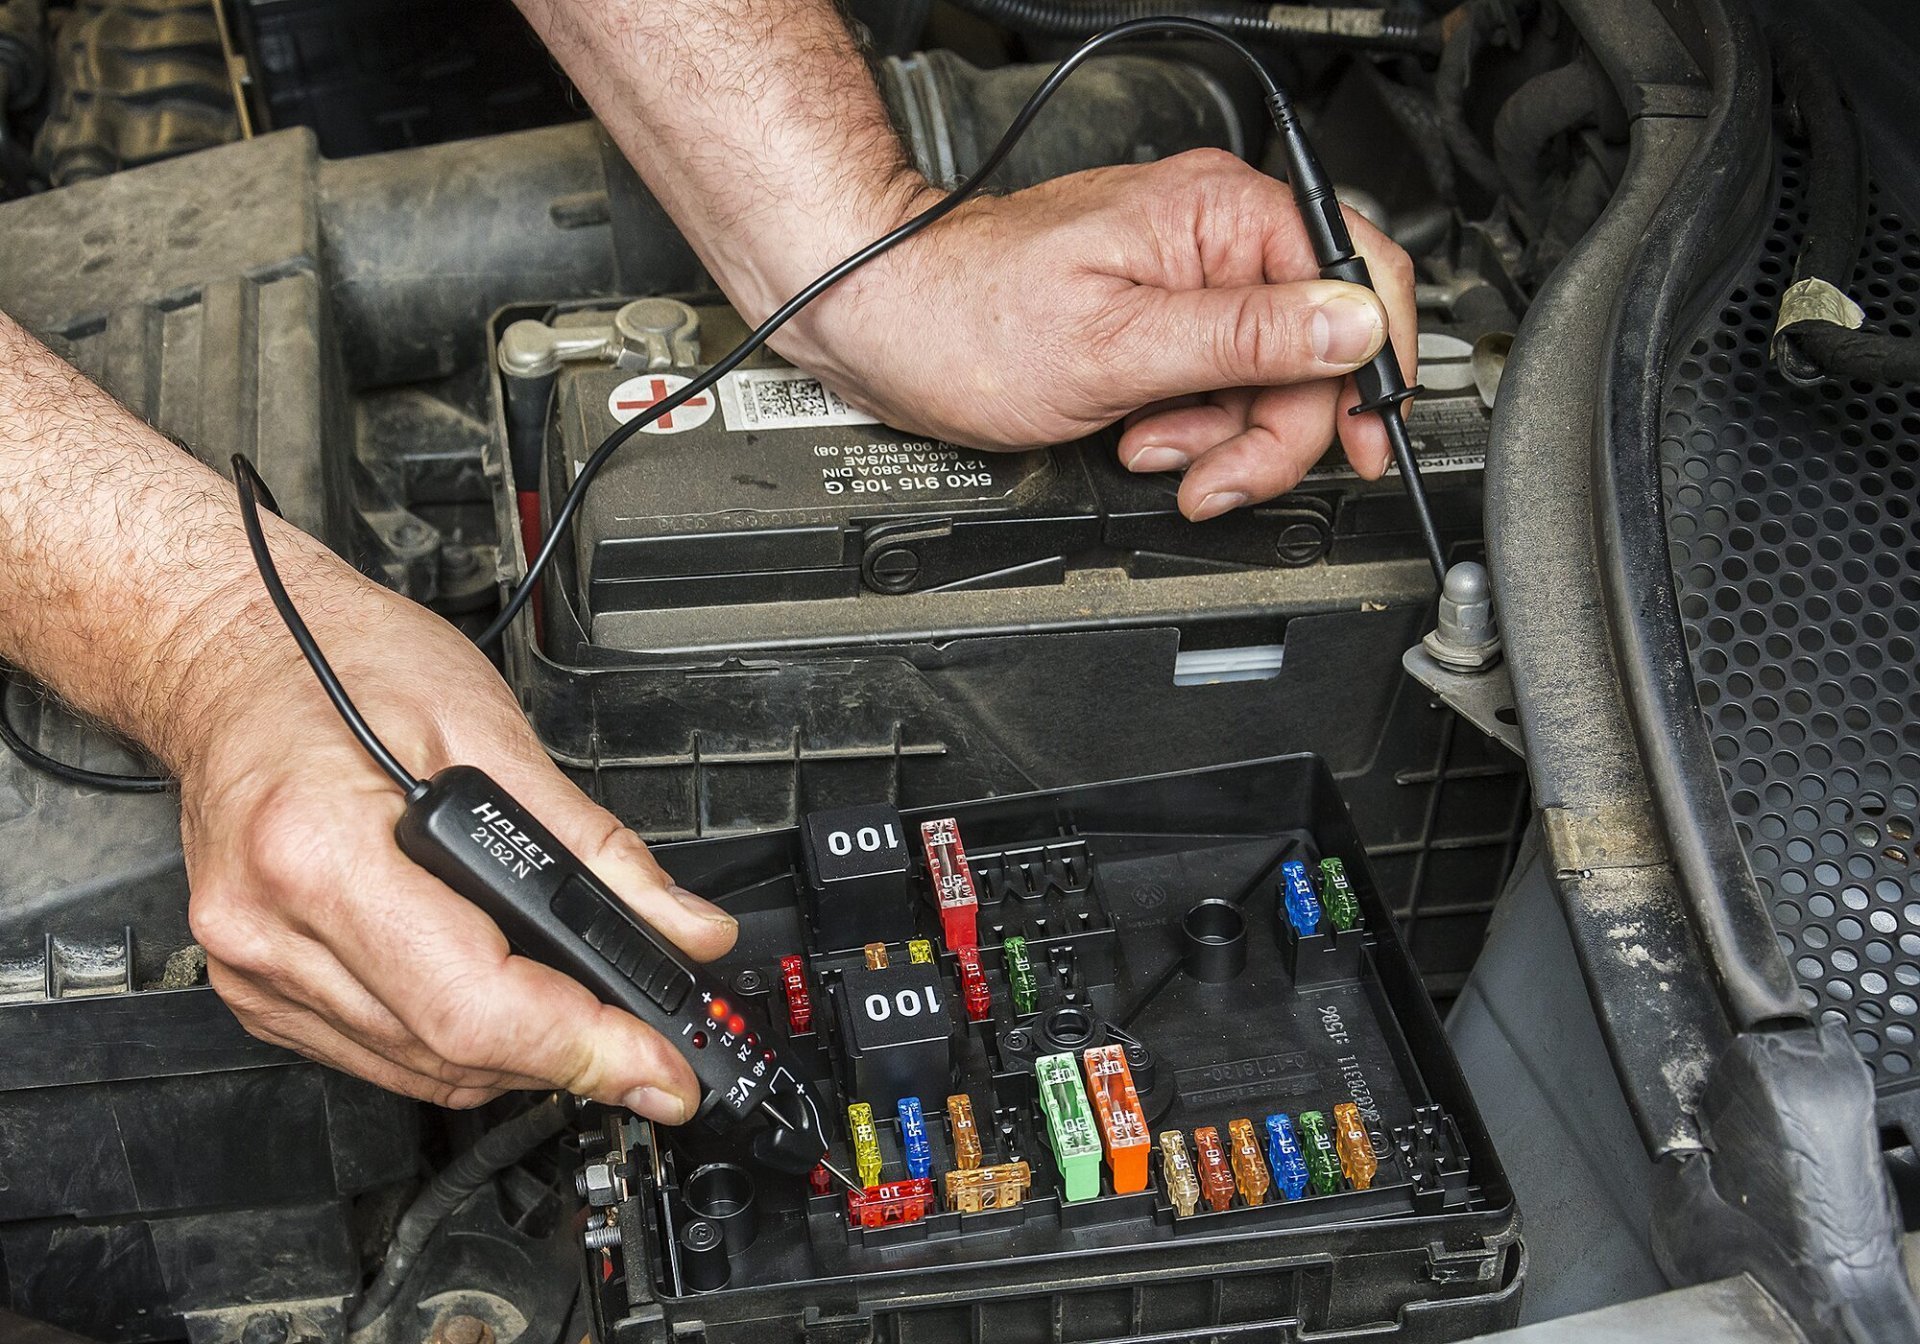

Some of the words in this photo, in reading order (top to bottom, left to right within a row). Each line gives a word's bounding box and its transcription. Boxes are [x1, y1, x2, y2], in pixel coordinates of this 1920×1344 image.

[813, 445, 839, 457] 08)
[844, 445, 863, 454] 04
[868, 443, 898, 453] 982
[902, 442, 932, 452] 906
[844, 453, 910, 466] EN/SAE
[929, 451, 959, 461] 640
[822, 467, 854, 478] DIN
[907, 462, 950, 473] 72Ah
[954, 460, 987, 471] 12V
[824, 481, 845, 495] G
[851, 479, 893, 493] 105
[898, 476, 940, 491] 915
[946, 473, 993, 488] 5K0
[471, 802, 556, 866] HAZET
[828, 823, 899, 856] 100
[470, 826, 515, 867] 2152
[511, 860, 531, 880] N
[1293, 879, 1311, 895] 15
[1332, 874, 1349, 889] 30
[966, 963, 981, 978] 10
[1015, 957, 1030, 973] 30
[788, 975, 802, 990] 10
[865, 985, 941, 1022] 100
[706, 1018, 717, 1030] 5
[720, 1031, 735, 1047] 12
[737, 1044, 751, 1061] 24
[753, 1061, 766, 1076] 48
[726, 1087, 739, 1101] DC
[957, 1120, 972, 1128] 5
[1064, 1117, 1089, 1133] 30
[1113, 1110, 1138, 1125] 40
[1278, 1137, 1296, 1155] 15
[1314, 1133, 1332, 1150] 30
[1241, 1147, 1256, 1155] 5
[1172, 1153, 1189, 1170] 25
[983, 1169, 994, 1180] 5
[879, 1185, 900, 1199] 10
